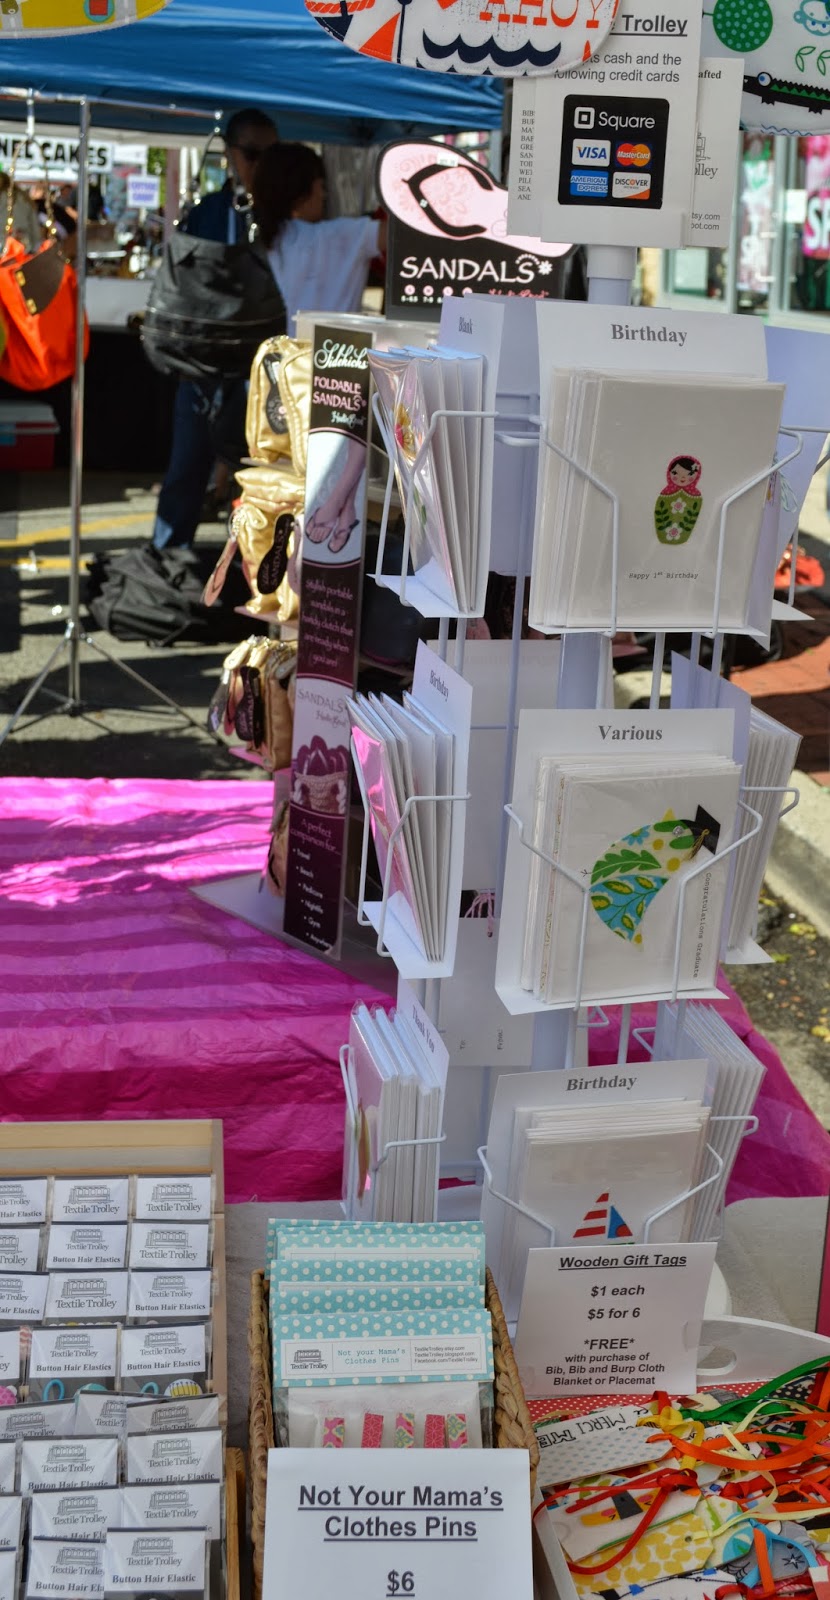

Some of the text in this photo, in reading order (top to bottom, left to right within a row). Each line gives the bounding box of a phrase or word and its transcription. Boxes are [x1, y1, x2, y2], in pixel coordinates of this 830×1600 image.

[622, 15, 688, 36] Trolley
[604, 52, 632, 65] cash
[636, 53, 659, 65] and
[663, 54, 682, 66] the
[609, 70, 643, 83] credit
[646, 71, 680, 83] cards
[598, 111, 656, 131] Square
[576, 146, 607, 160] VISA
[617, 150, 651, 160] MasterCard
[570, 175, 607, 185] AMERICAN
[614, 178, 649, 187] DISCOVER
[577, 184, 608, 193] EXPRESS
[400, 256, 535, 284] SANDALS
[458, 317, 473, 335] Blank
[611, 323, 687, 347] Birthday
[314, 376, 361, 395] FOLDABLE
[313, 391, 361, 411] SANDALS
[629, 572, 650, 580] Happy
[666, 572, 699, 580] Birthday
[430, 669, 448, 702] Birthday
[298, 689, 344, 713] SANDALS
[598, 725, 663, 741] Various
[693, 872, 712, 978] Congratulations Graduate
[412, 1004, 435, 1054] Thank You
[566, 1075, 637, 1091] Birthday
[63, 1204, 120, 1214] Textile Trolley
[146, 1203, 202, 1213] Textile Trolley
[87, 1243, 109, 1251] Trolley
[0, 1255, 28, 1265] Trolley
[139, 1250, 198, 1260] Textile Trolley
[560, 1254, 687, 1269] Wooden Gift Tags
[148, 1290, 193, 1299] Textile Trolley
[590, 1284, 645, 1298] $1 each
[6, 1294, 29, 1302] Trolley
[55, 1299, 117, 1309] Textile Trolley
[179, 1303, 206, 1311] Elastics
[587, 1307, 641, 1321] $5 for 6
[50, 1350, 99, 1358] Textile Trolley
[140, 1347, 187, 1356] Textile Trolley
[565, 1352, 650, 1364] with purchase of
[83, 1363, 112, 1371] Elastics
[127, 1363, 152, 1371] Button
[172, 1360, 201, 1368] Elastics
[309, 1362, 328, 1370] Trolley
[546, 1363, 665, 1375] Bib, Bib and Burp Cloth
[553, 1377, 592, 1386] Blanket
[608, 1376, 656, 1385] Placemat
[95, 1419, 120, 1427] Textile
[575, 1412, 626, 1435] MERCI
[28, 1429, 55, 1437] Trolley
[147, 1457, 200, 1468] Textile Trolley
[42, 1464, 95, 1473] Textile Trolley
[187, 1472, 215, 1480] Elastic
[299, 1485, 341, 1506] Not
[348, 1485, 406, 1506] Your
[144, 1509, 199, 1518] Textile Trolley
[53, 1515, 107, 1525] Textile Trolley
[325, 1516, 477, 1537] Clothes Pins
[127, 1557, 182, 1567] Textile Trolley
[51, 1565, 78, 1574] Textile
[112, 1573, 196, 1583] Button Hair Elastic
[386, 1569, 415, 1595] $6
[36, 1581, 65, 1590] Button
[68, 1583, 88, 1591] Hair
